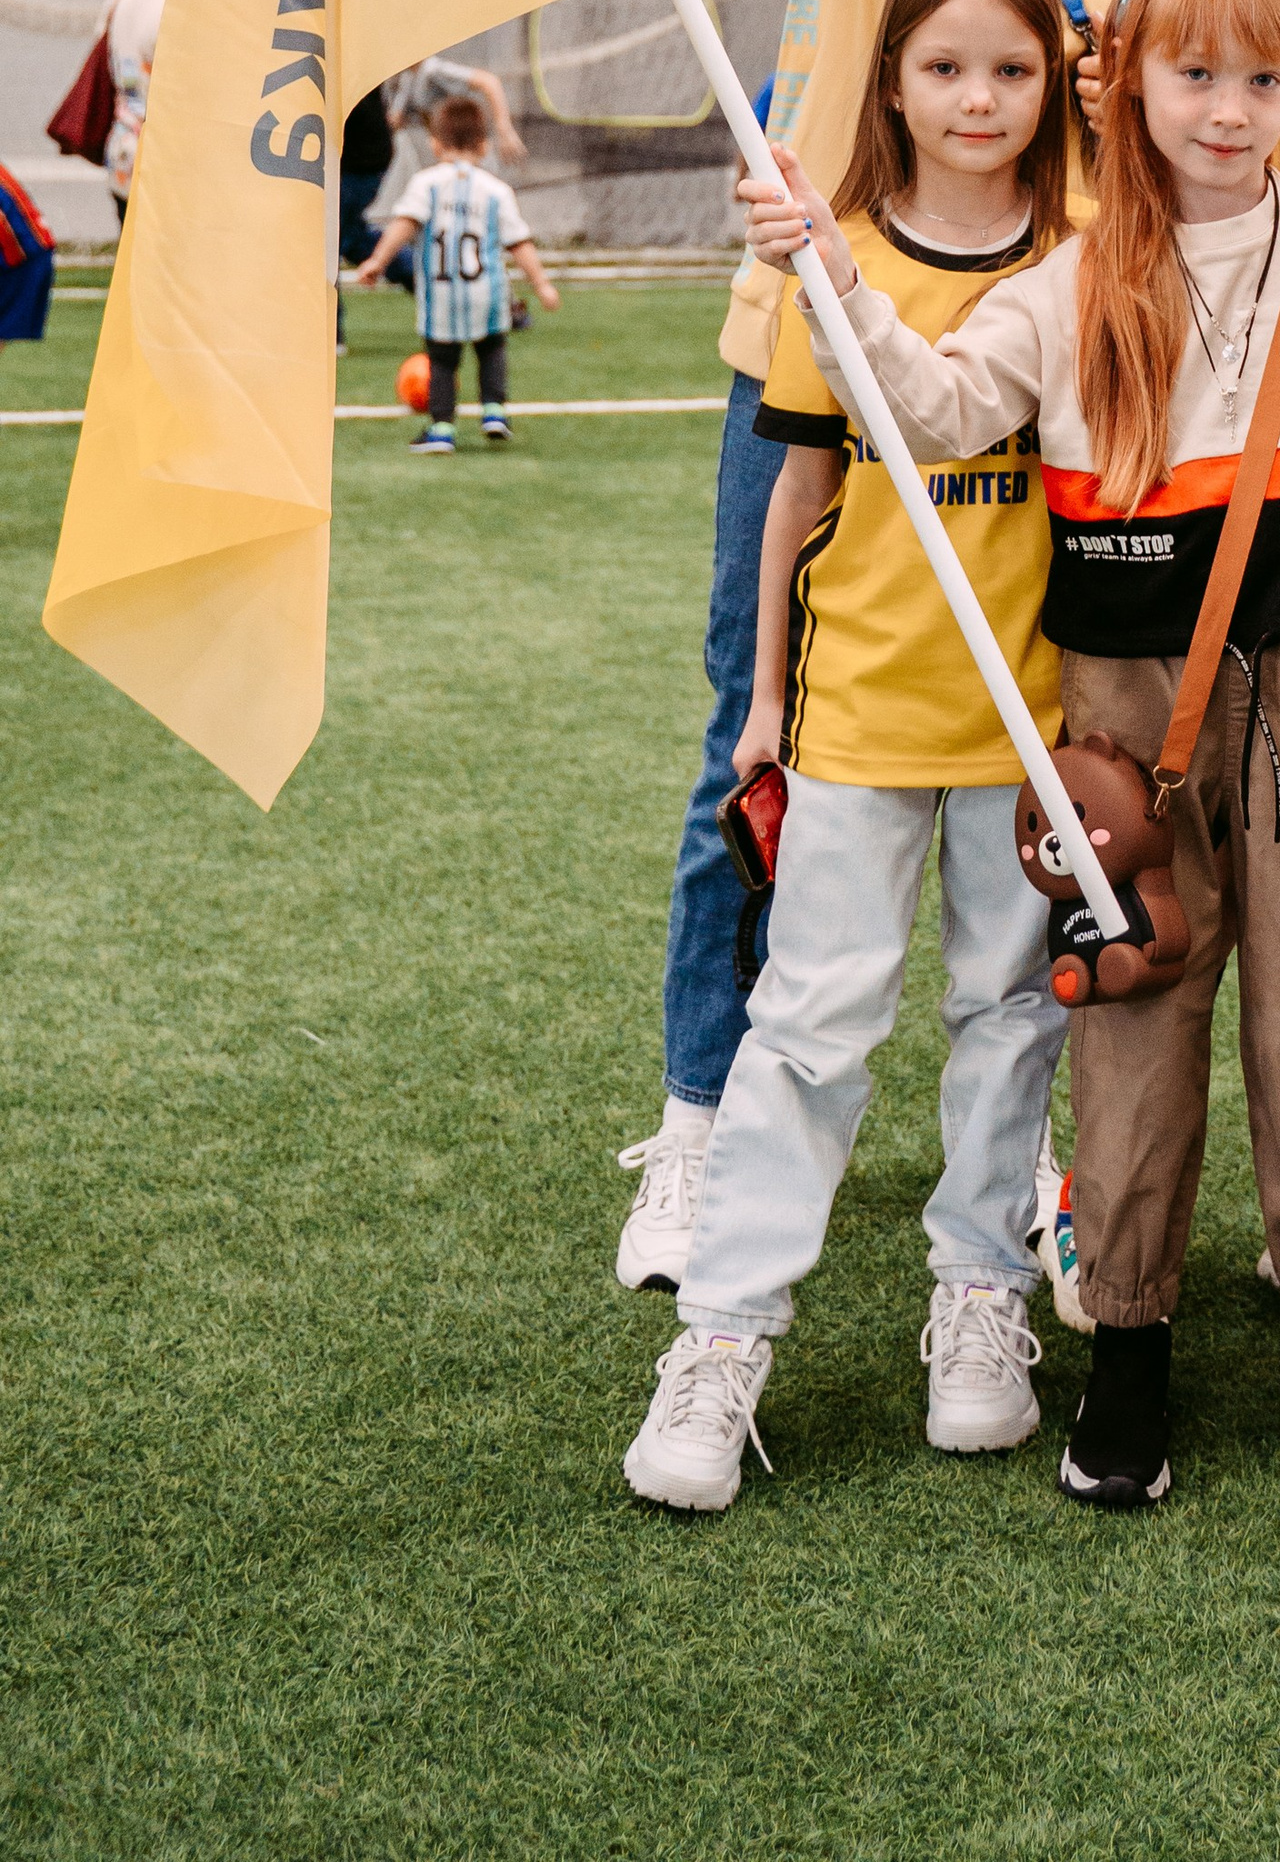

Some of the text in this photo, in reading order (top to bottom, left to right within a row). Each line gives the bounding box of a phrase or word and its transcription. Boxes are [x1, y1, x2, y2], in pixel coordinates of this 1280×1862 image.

[434, 229, 483, 281] 10
[928, 470, 1029, 507] UNITED
[1130, 533, 1175, 555] STOP
[1073, 929, 1101, 944] HONEY
